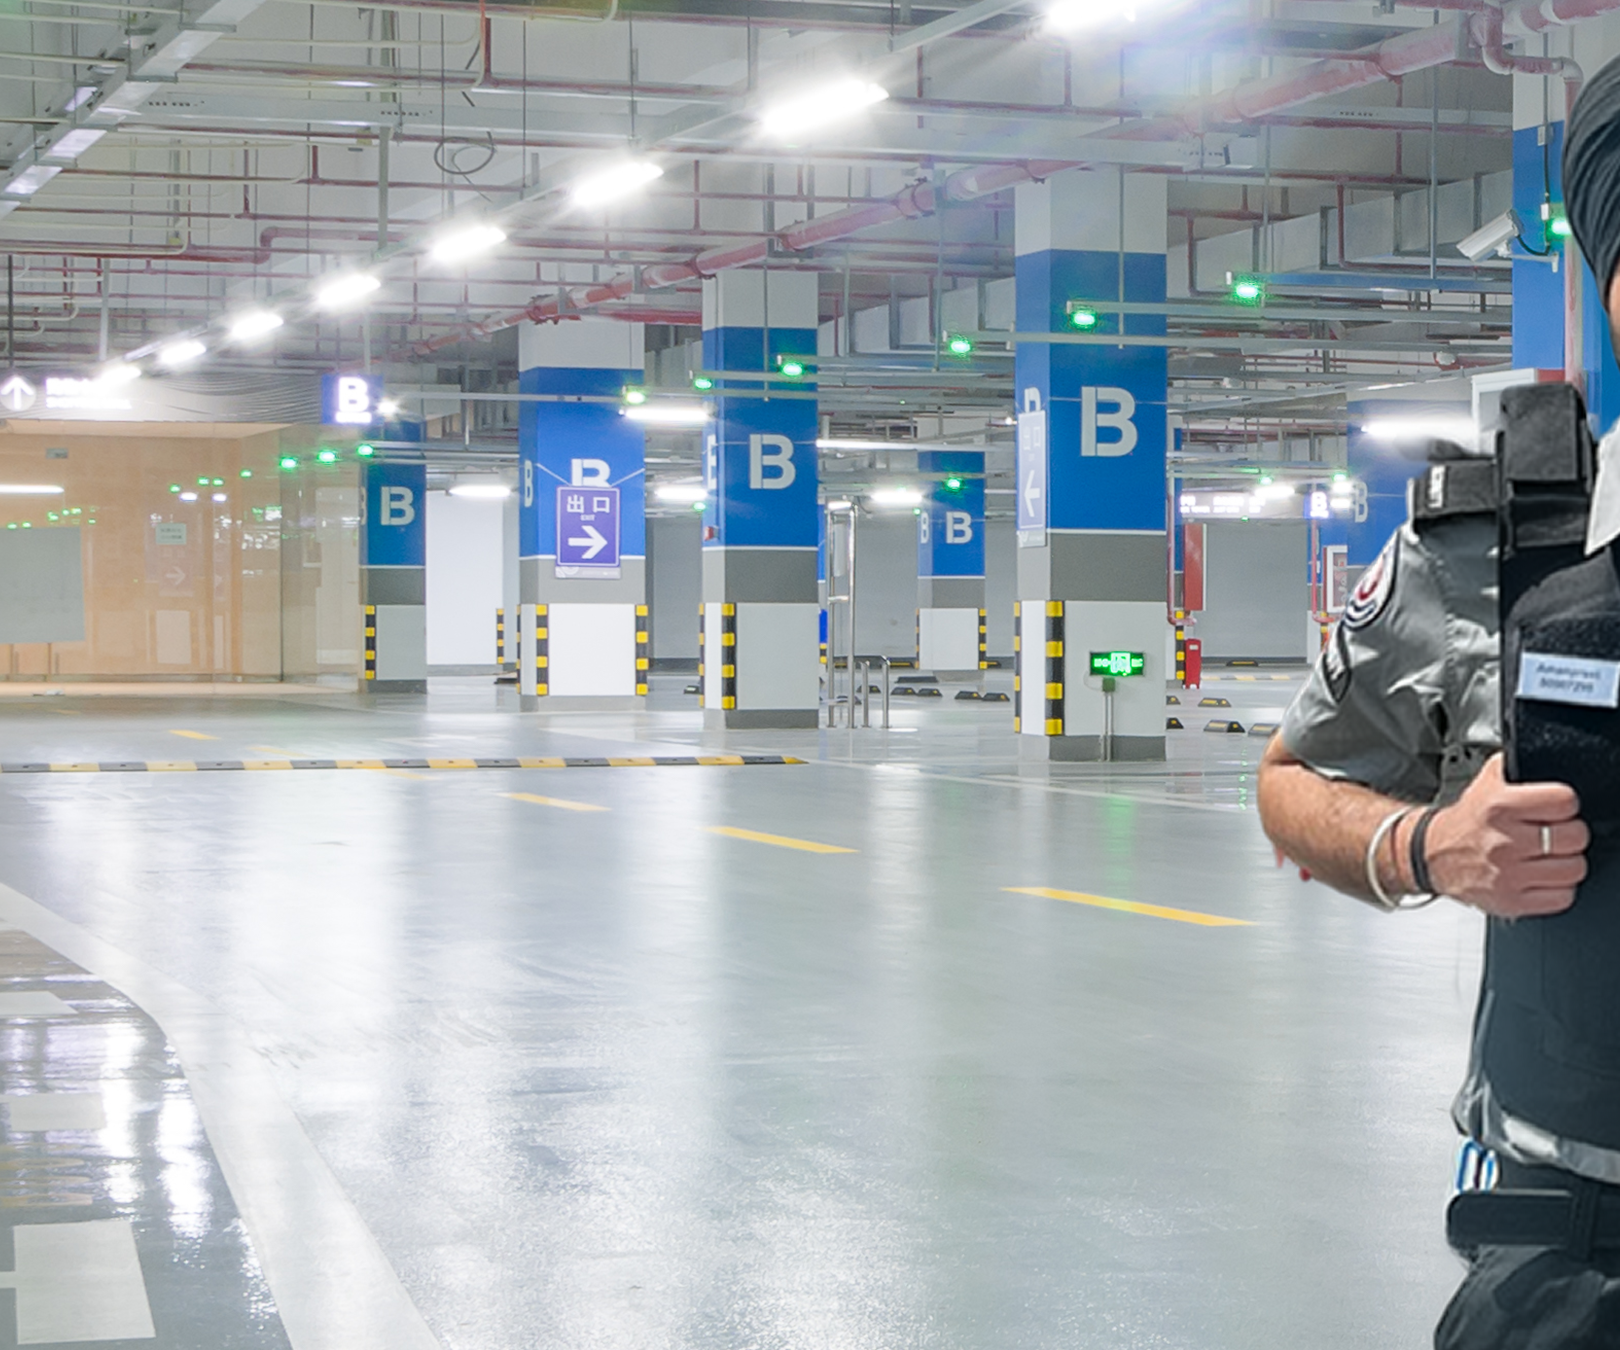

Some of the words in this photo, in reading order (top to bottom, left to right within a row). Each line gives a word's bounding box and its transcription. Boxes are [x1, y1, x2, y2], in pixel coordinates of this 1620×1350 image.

[338, 377, 369, 411] B
[1081, 386, 1138, 456] B
[749, 434, 796, 489] B
[524, 460, 533, 508] B
[567, 494, 611, 513] 出口
[1355, 481, 1368, 523] B
[380, 486, 415, 526] B
[946, 511, 973, 544] B
